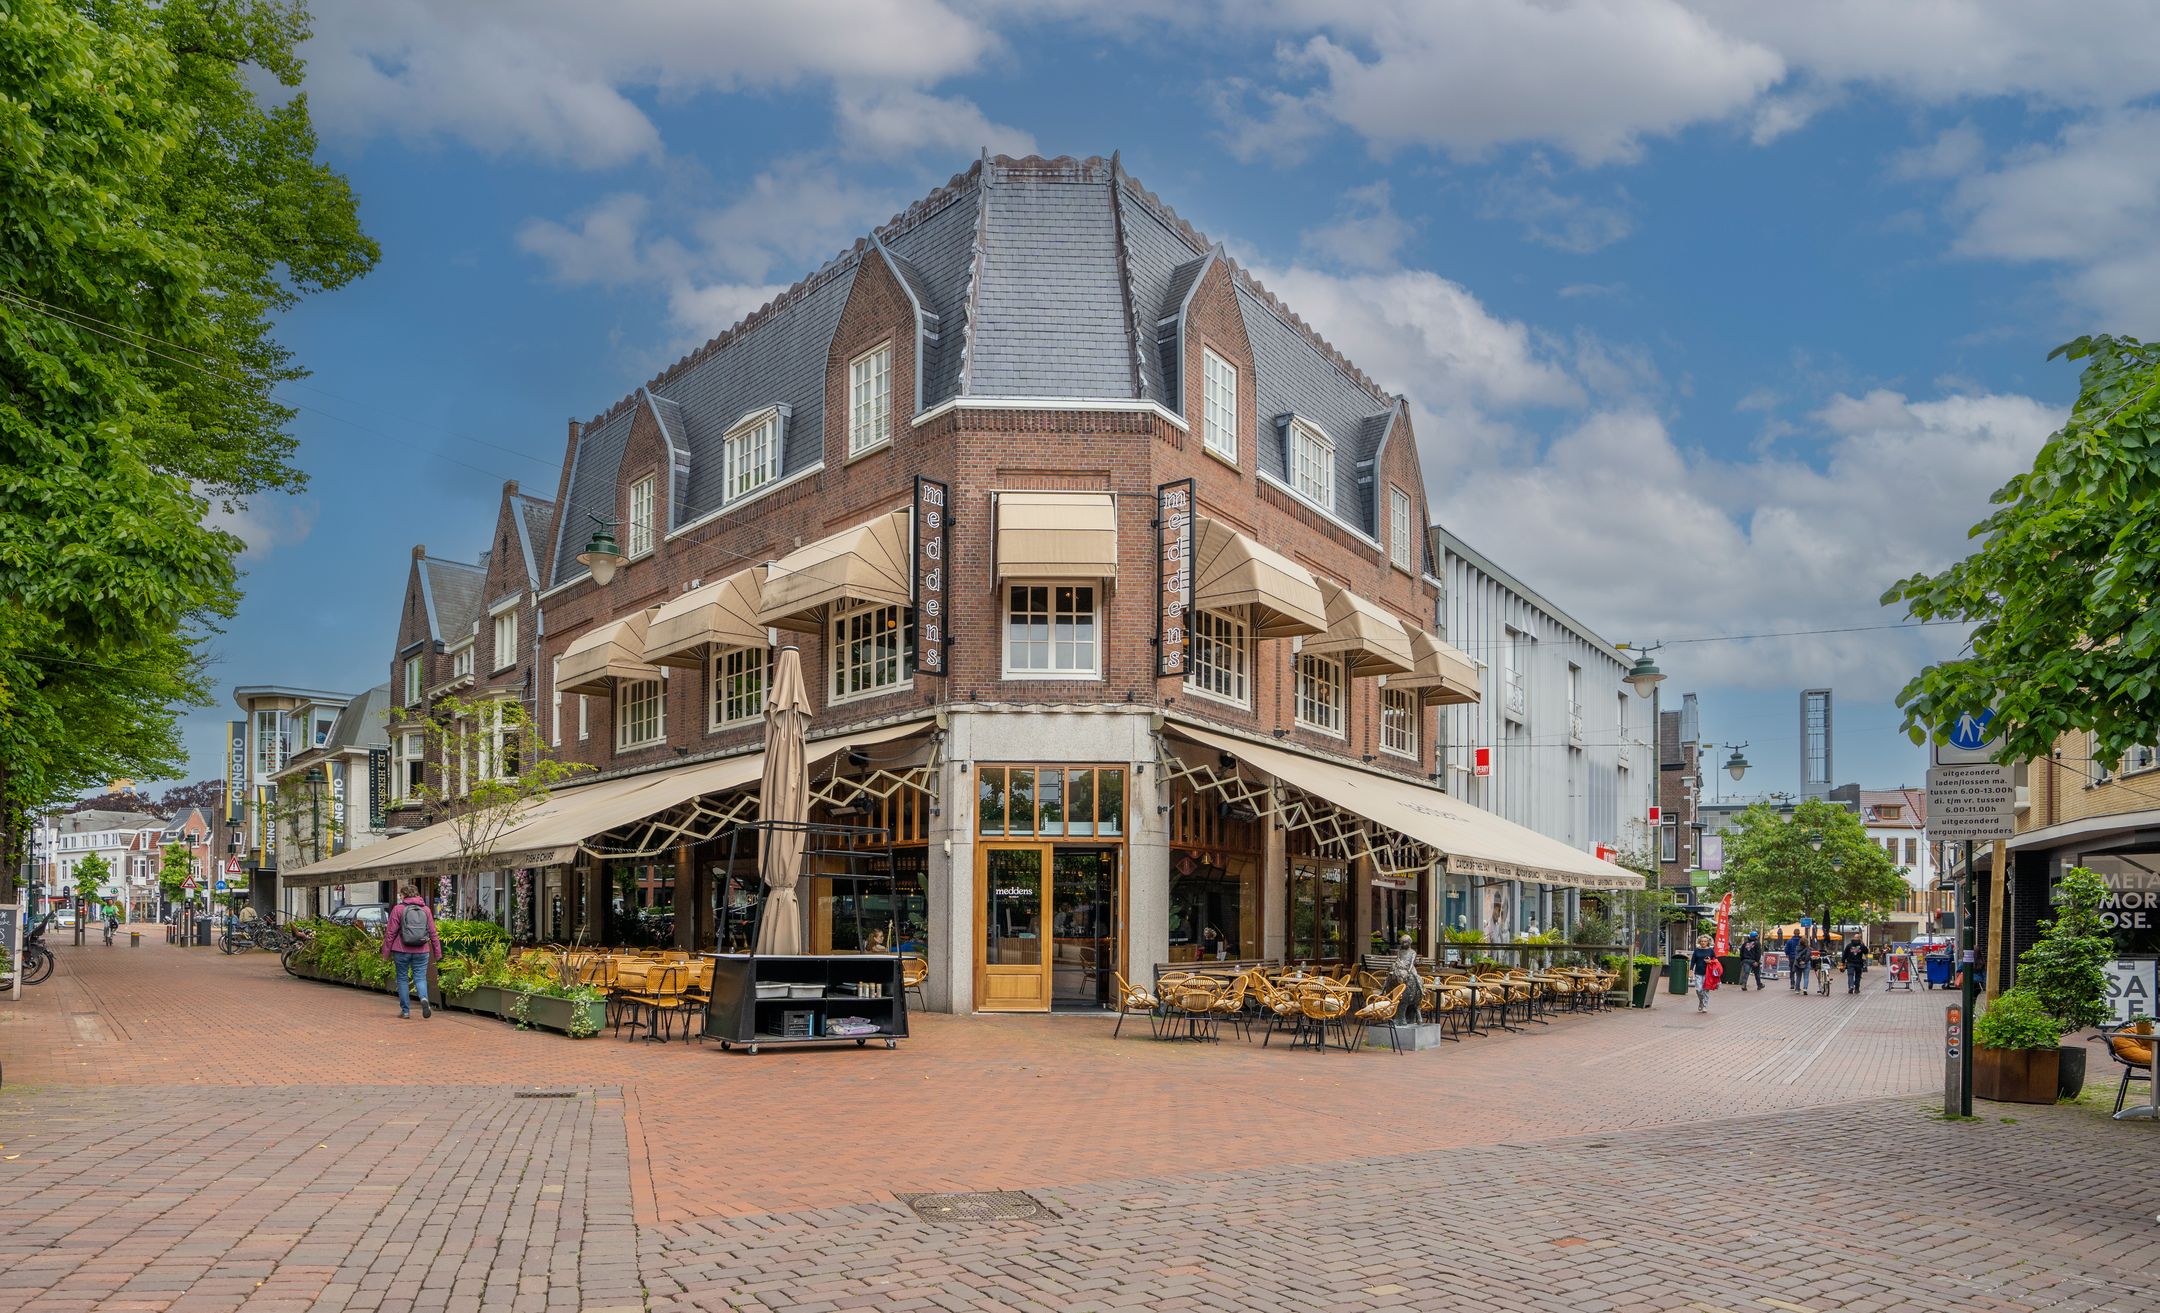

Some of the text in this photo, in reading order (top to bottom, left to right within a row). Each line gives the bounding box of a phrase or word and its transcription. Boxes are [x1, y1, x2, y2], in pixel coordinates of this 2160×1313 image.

[923, 484, 944, 666] meddens
[1164, 489, 1186, 668] meddens
[378, 754, 386, 768] DE
[1943, 769, 2000, 777] uitgezonderd
[1942, 818, 1999, 826] uitgezonderd
[526, 854, 536, 863] FISH
[540, 852, 554, 861] CHIPS
[996, 886, 1032, 895] meddens
[2099, 892, 2158, 909] MOR
[2100, 912, 2152, 929] OSE.
[2106, 974, 2148, 998] SA
